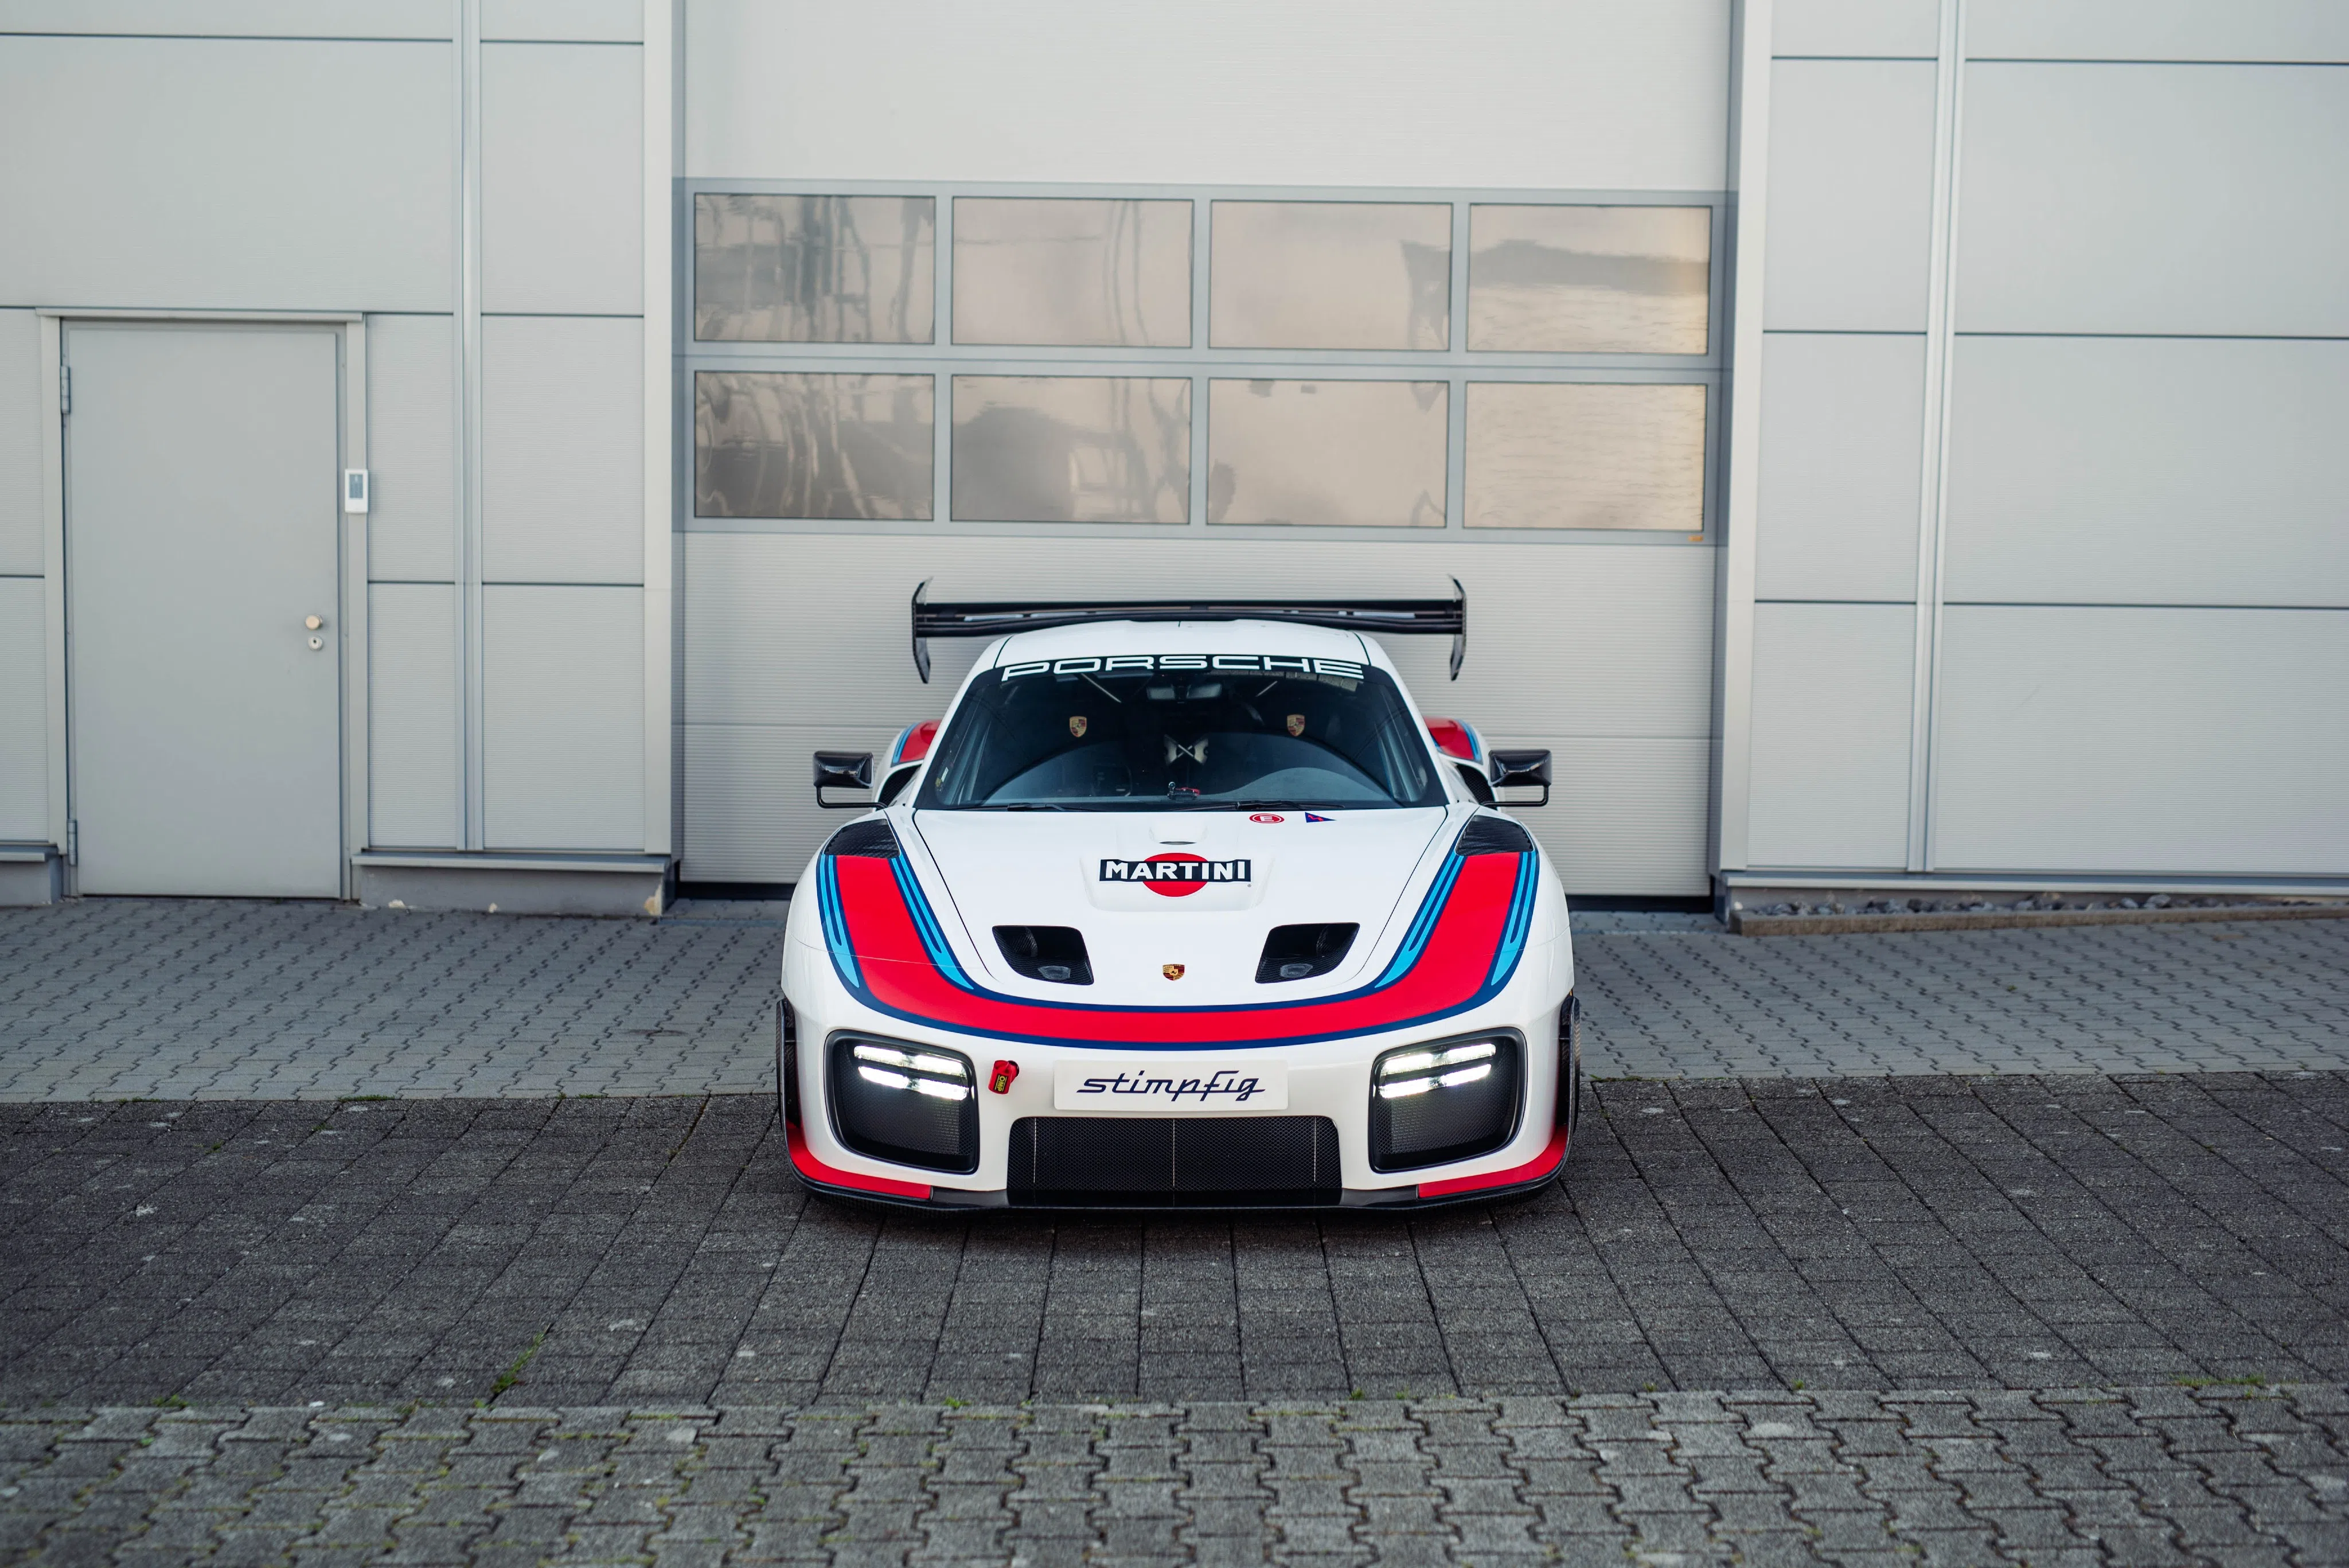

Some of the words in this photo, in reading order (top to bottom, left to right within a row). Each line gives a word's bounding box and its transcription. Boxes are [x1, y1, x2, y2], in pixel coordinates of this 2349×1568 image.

[1001, 655, 1364, 681] PORSCHE
[1105, 860, 1246, 880] MARTINI
[997, 1075, 1006, 1091] OMP
[1076, 1070, 1266, 1102] stimpfig
